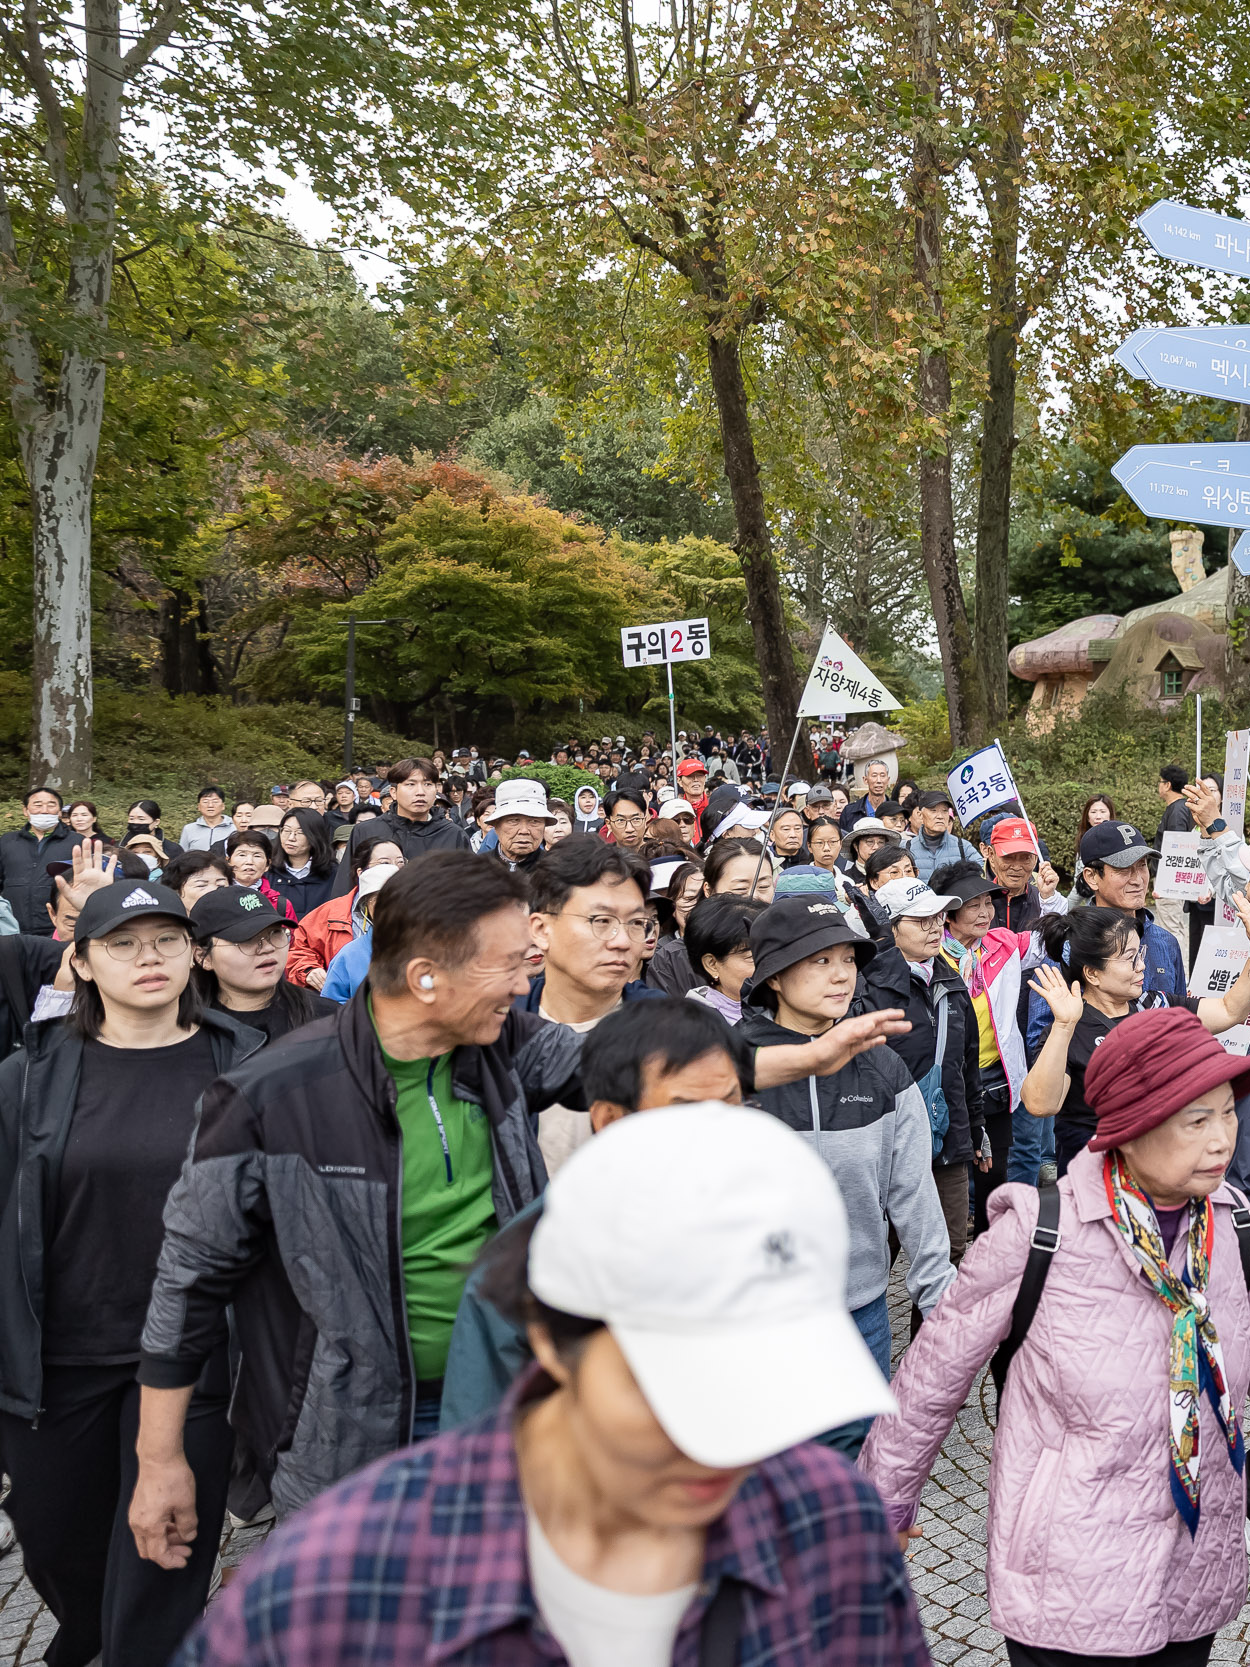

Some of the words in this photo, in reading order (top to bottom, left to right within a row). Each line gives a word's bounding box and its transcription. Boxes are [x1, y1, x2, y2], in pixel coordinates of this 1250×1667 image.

[1163, 223, 1187, 238] 14,142
[1189, 230, 1201, 241] km
[1160, 352, 1184, 365] 12,047
[1185, 358, 1197, 369] km
[1149, 482, 1174, 495] 11,172
[1176, 486, 1189, 497] km
[626, 623, 708, 663] 구의2동
[813, 666, 883, 708] 자양제4동
[956, 772, 1007, 816] 중곡3동
[121, 898, 159, 909] adidas
[1208, 969, 1231, 992] 생활
[847, 1094, 874, 1103] Columbia
